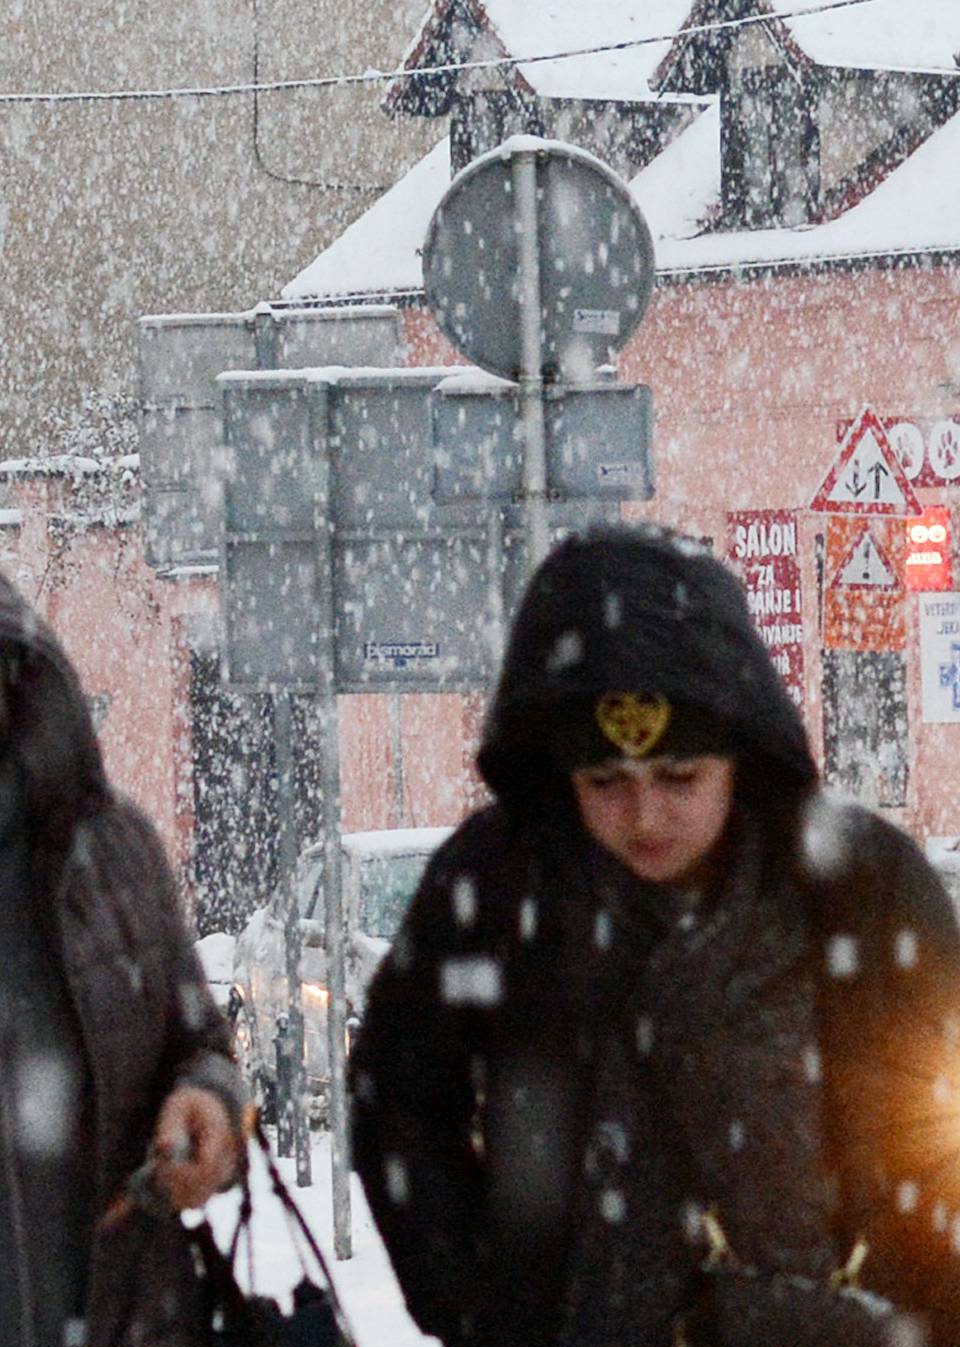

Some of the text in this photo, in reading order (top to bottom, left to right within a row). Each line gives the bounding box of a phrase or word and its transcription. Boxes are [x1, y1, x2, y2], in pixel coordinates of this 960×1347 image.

[735, 524, 796, 557] SALON
[907, 524, 947, 543] OO
[757, 565, 774, 586] ZA
